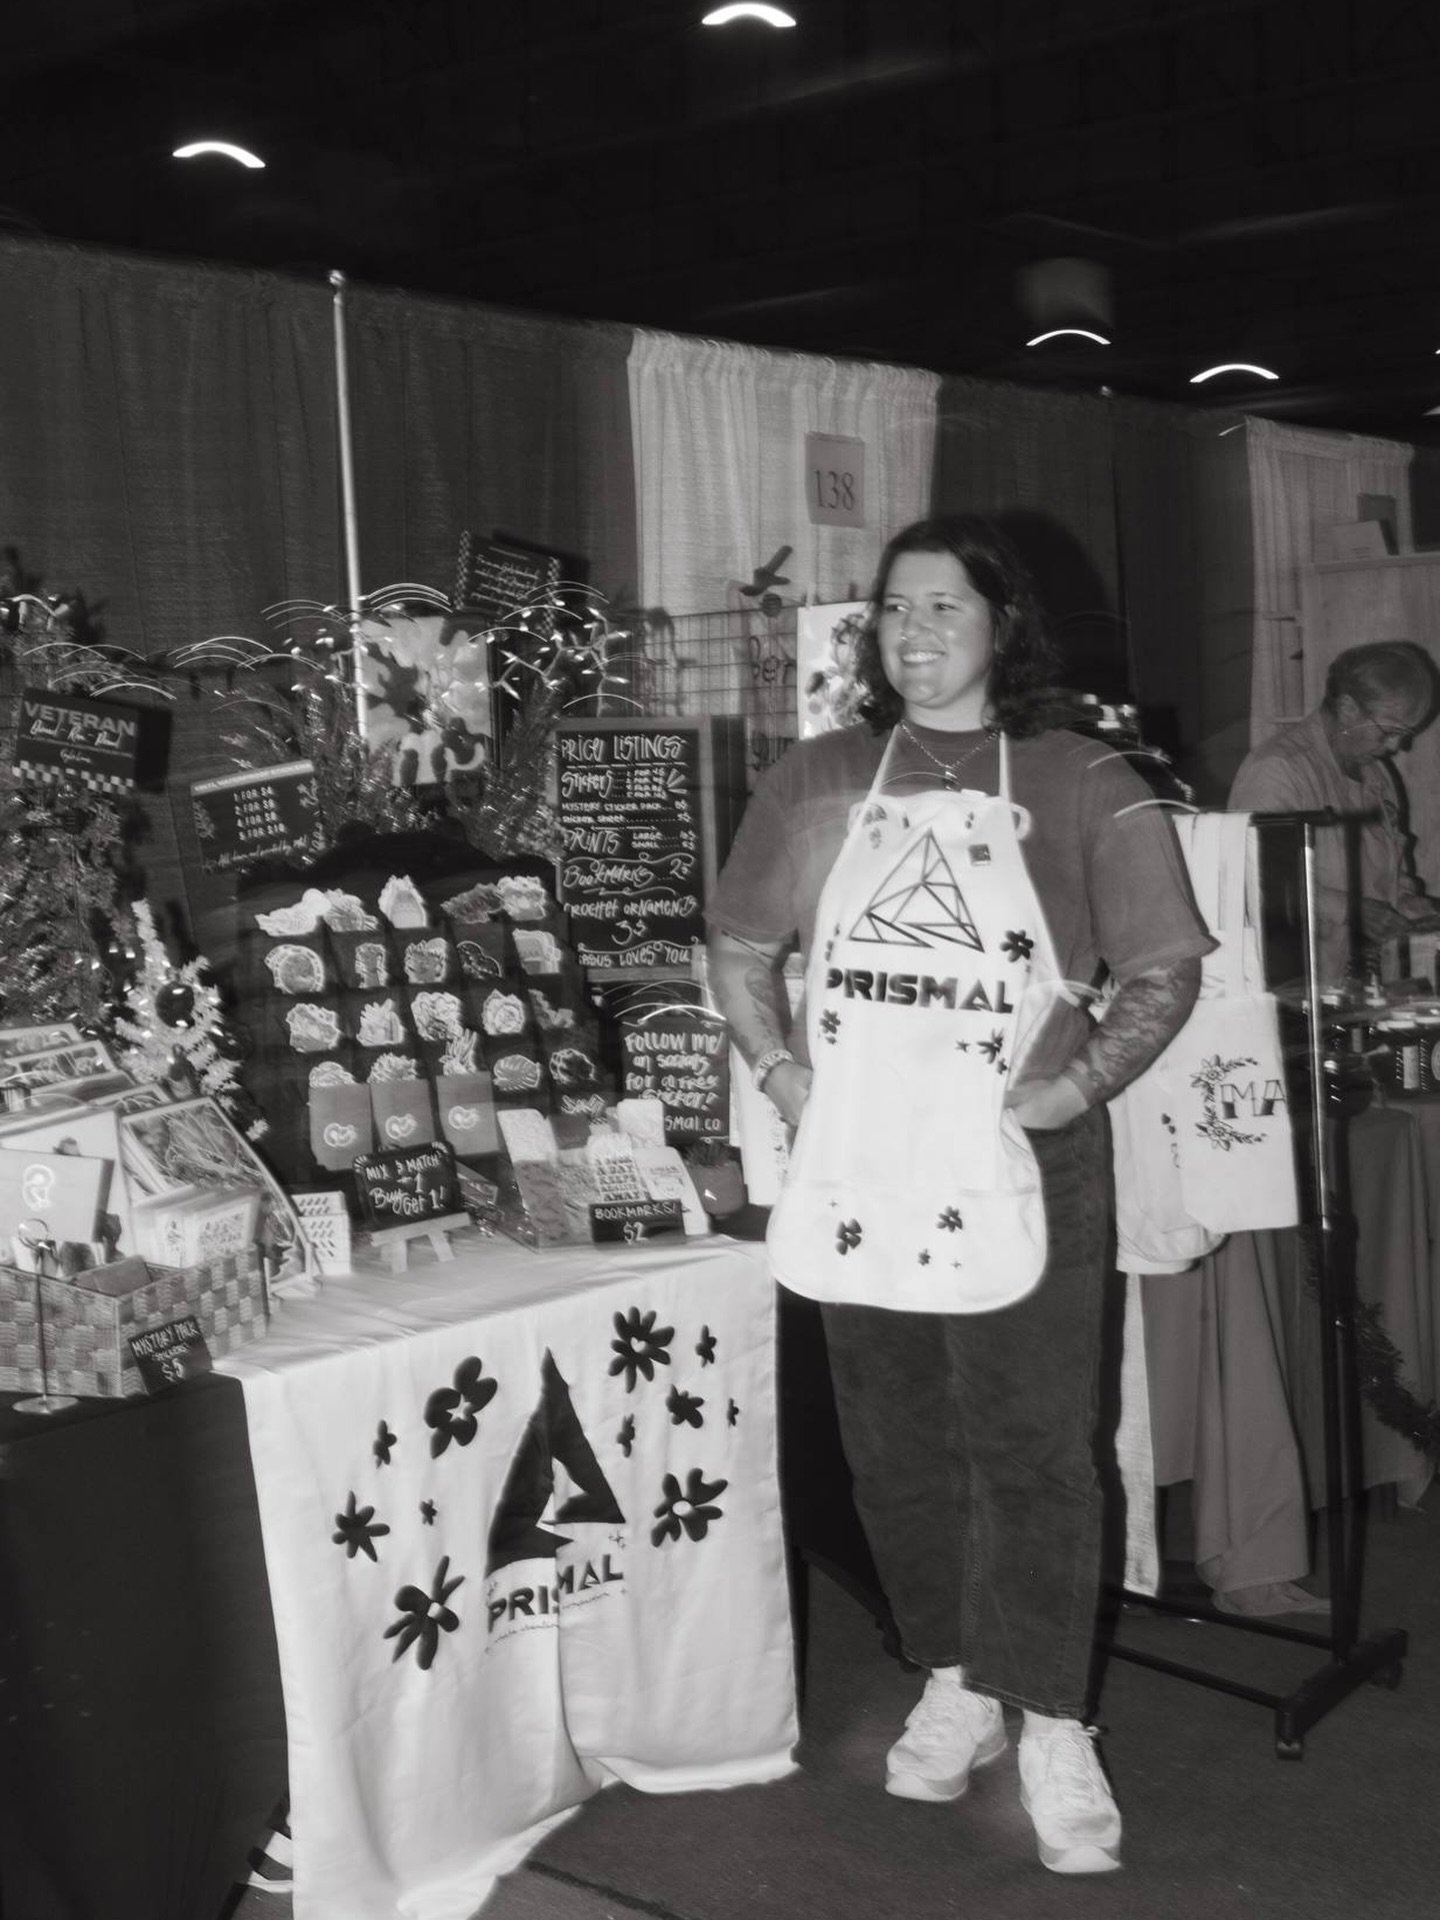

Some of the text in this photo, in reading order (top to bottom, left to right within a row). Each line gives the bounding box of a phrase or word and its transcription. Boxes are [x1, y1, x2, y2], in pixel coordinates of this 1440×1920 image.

[814, 469, 855, 511] 138
[24, 701, 136, 737] VETERAN
[614, 735, 684, 760] LISTINGS
[619, 945, 655, 966] LOVES
[664, 947, 690, 963] YOU
[826, 968, 1014, 1014] PRISMAL
[626, 1072, 654, 1090] for
[661, 1075, 675, 1087] a
[366, 1163, 389, 1180] MIX
[369, 1186, 409, 1215] Buy
[623, 1221, 648, 1245] $2
